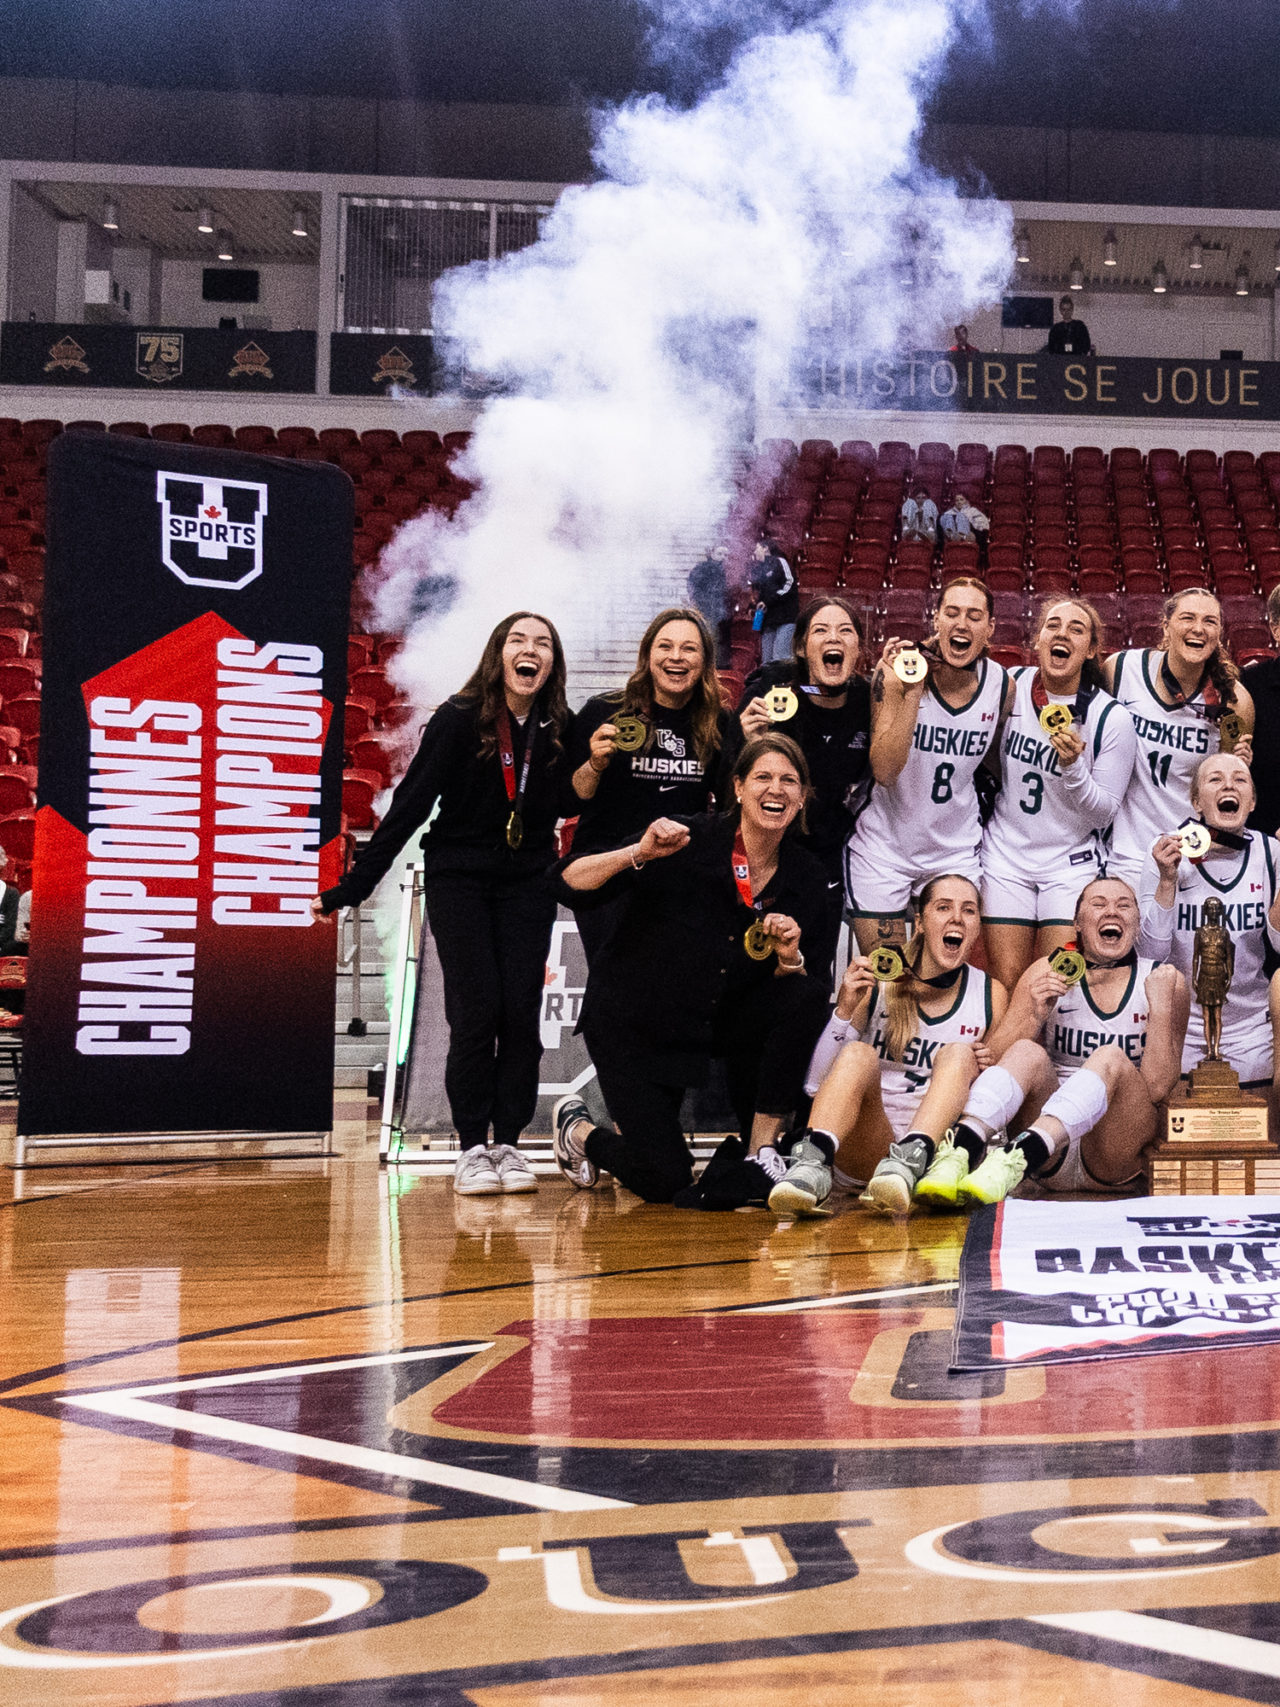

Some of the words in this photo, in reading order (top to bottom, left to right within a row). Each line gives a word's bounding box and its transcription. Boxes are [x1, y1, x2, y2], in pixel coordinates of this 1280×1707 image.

[140, 336, 181, 362] 75
[1064, 364, 1117, 402] SE
[1142, 367, 1260, 406] JOUE
[169, 518, 256, 546] SPORTS
[912, 723, 989, 757] HUSKIES
[1005, 730, 1063, 778] HUSKI
[212, 637, 324, 927] CHAMPIONS
[631, 757, 704, 775] HUSKIES
[931, 762, 955, 804] 8
[1147, 750, 1173, 788] 11
[1019, 771, 1044, 815] 3
[75, 695, 202, 1056] CHAMPIONNES
[1177, 902, 1265, 931] HUKIES
